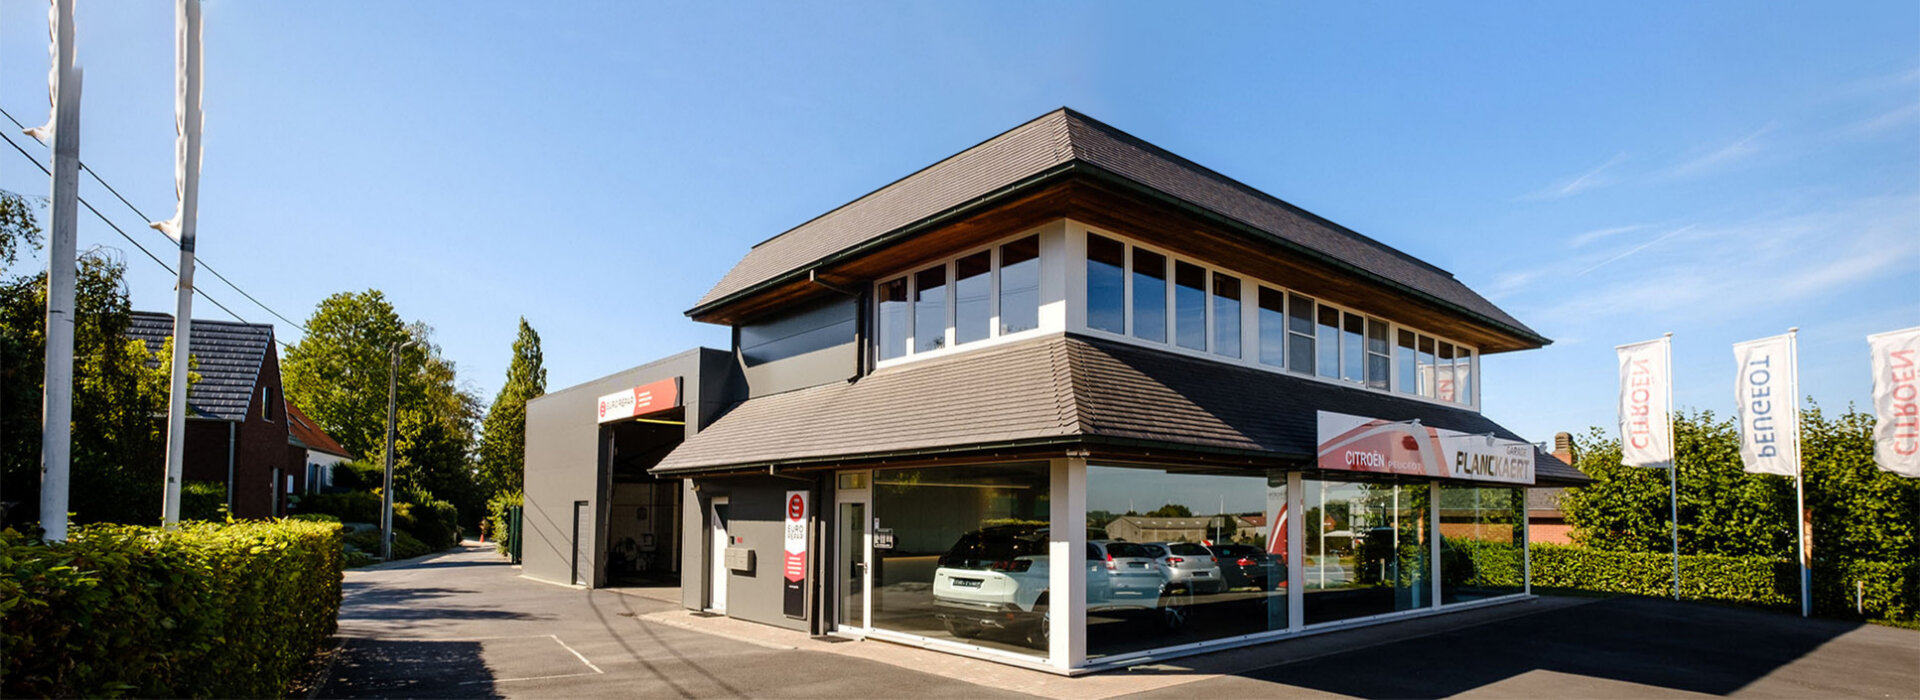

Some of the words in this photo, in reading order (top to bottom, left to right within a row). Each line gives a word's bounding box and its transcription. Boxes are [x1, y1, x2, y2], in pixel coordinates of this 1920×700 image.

[1345, 450, 1385, 467] CITROËN
[1388, 460, 1421, 471] PEUGEOT
[1455, 451, 1530, 479] PLANCKAERT
